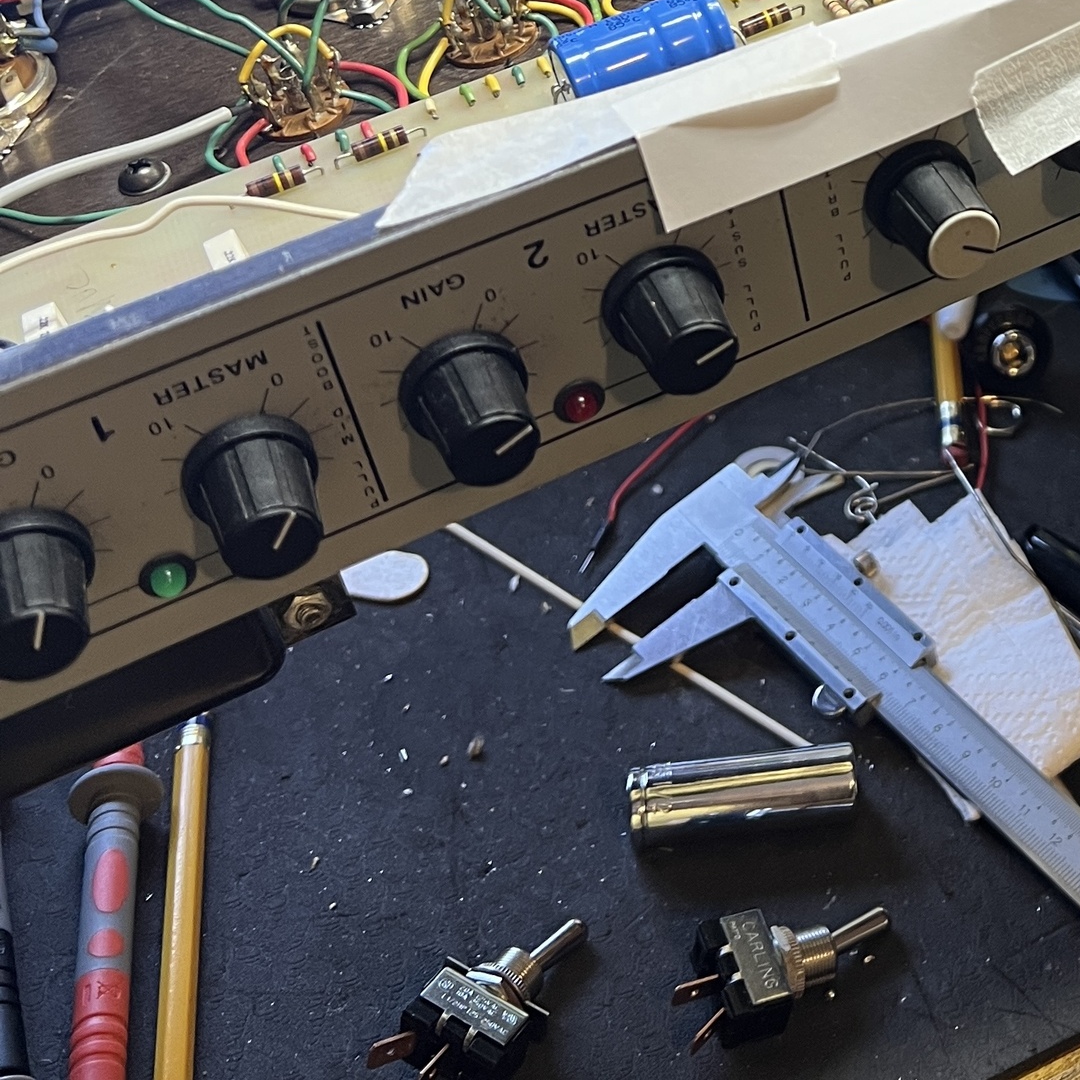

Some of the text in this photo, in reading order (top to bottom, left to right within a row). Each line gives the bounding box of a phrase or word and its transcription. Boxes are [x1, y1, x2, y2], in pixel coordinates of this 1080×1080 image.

[583, 198, 660, 239] ASTER
[726, 208, 748, 269] SUST
[523, 238, 551, 270] 2
[575, 248, 601, 267] 10
[834, 232, 852, 282] PULL
[400, 272, 467, 311] GAIN
[741, 283, 763, 333] PULL
[368, 329, 394, 349] 10
[152, 349, 269, 407] MASTER
[90, 415, 116, 443] 1
[147, 417, 174, 437] 10
[303, 325, 381, 510] PULL MID BOOST
[989, 775, 1003, 790] 10
[1049, 832, 1063, 846] 12
[740, 920, 781, 992] CARLING
